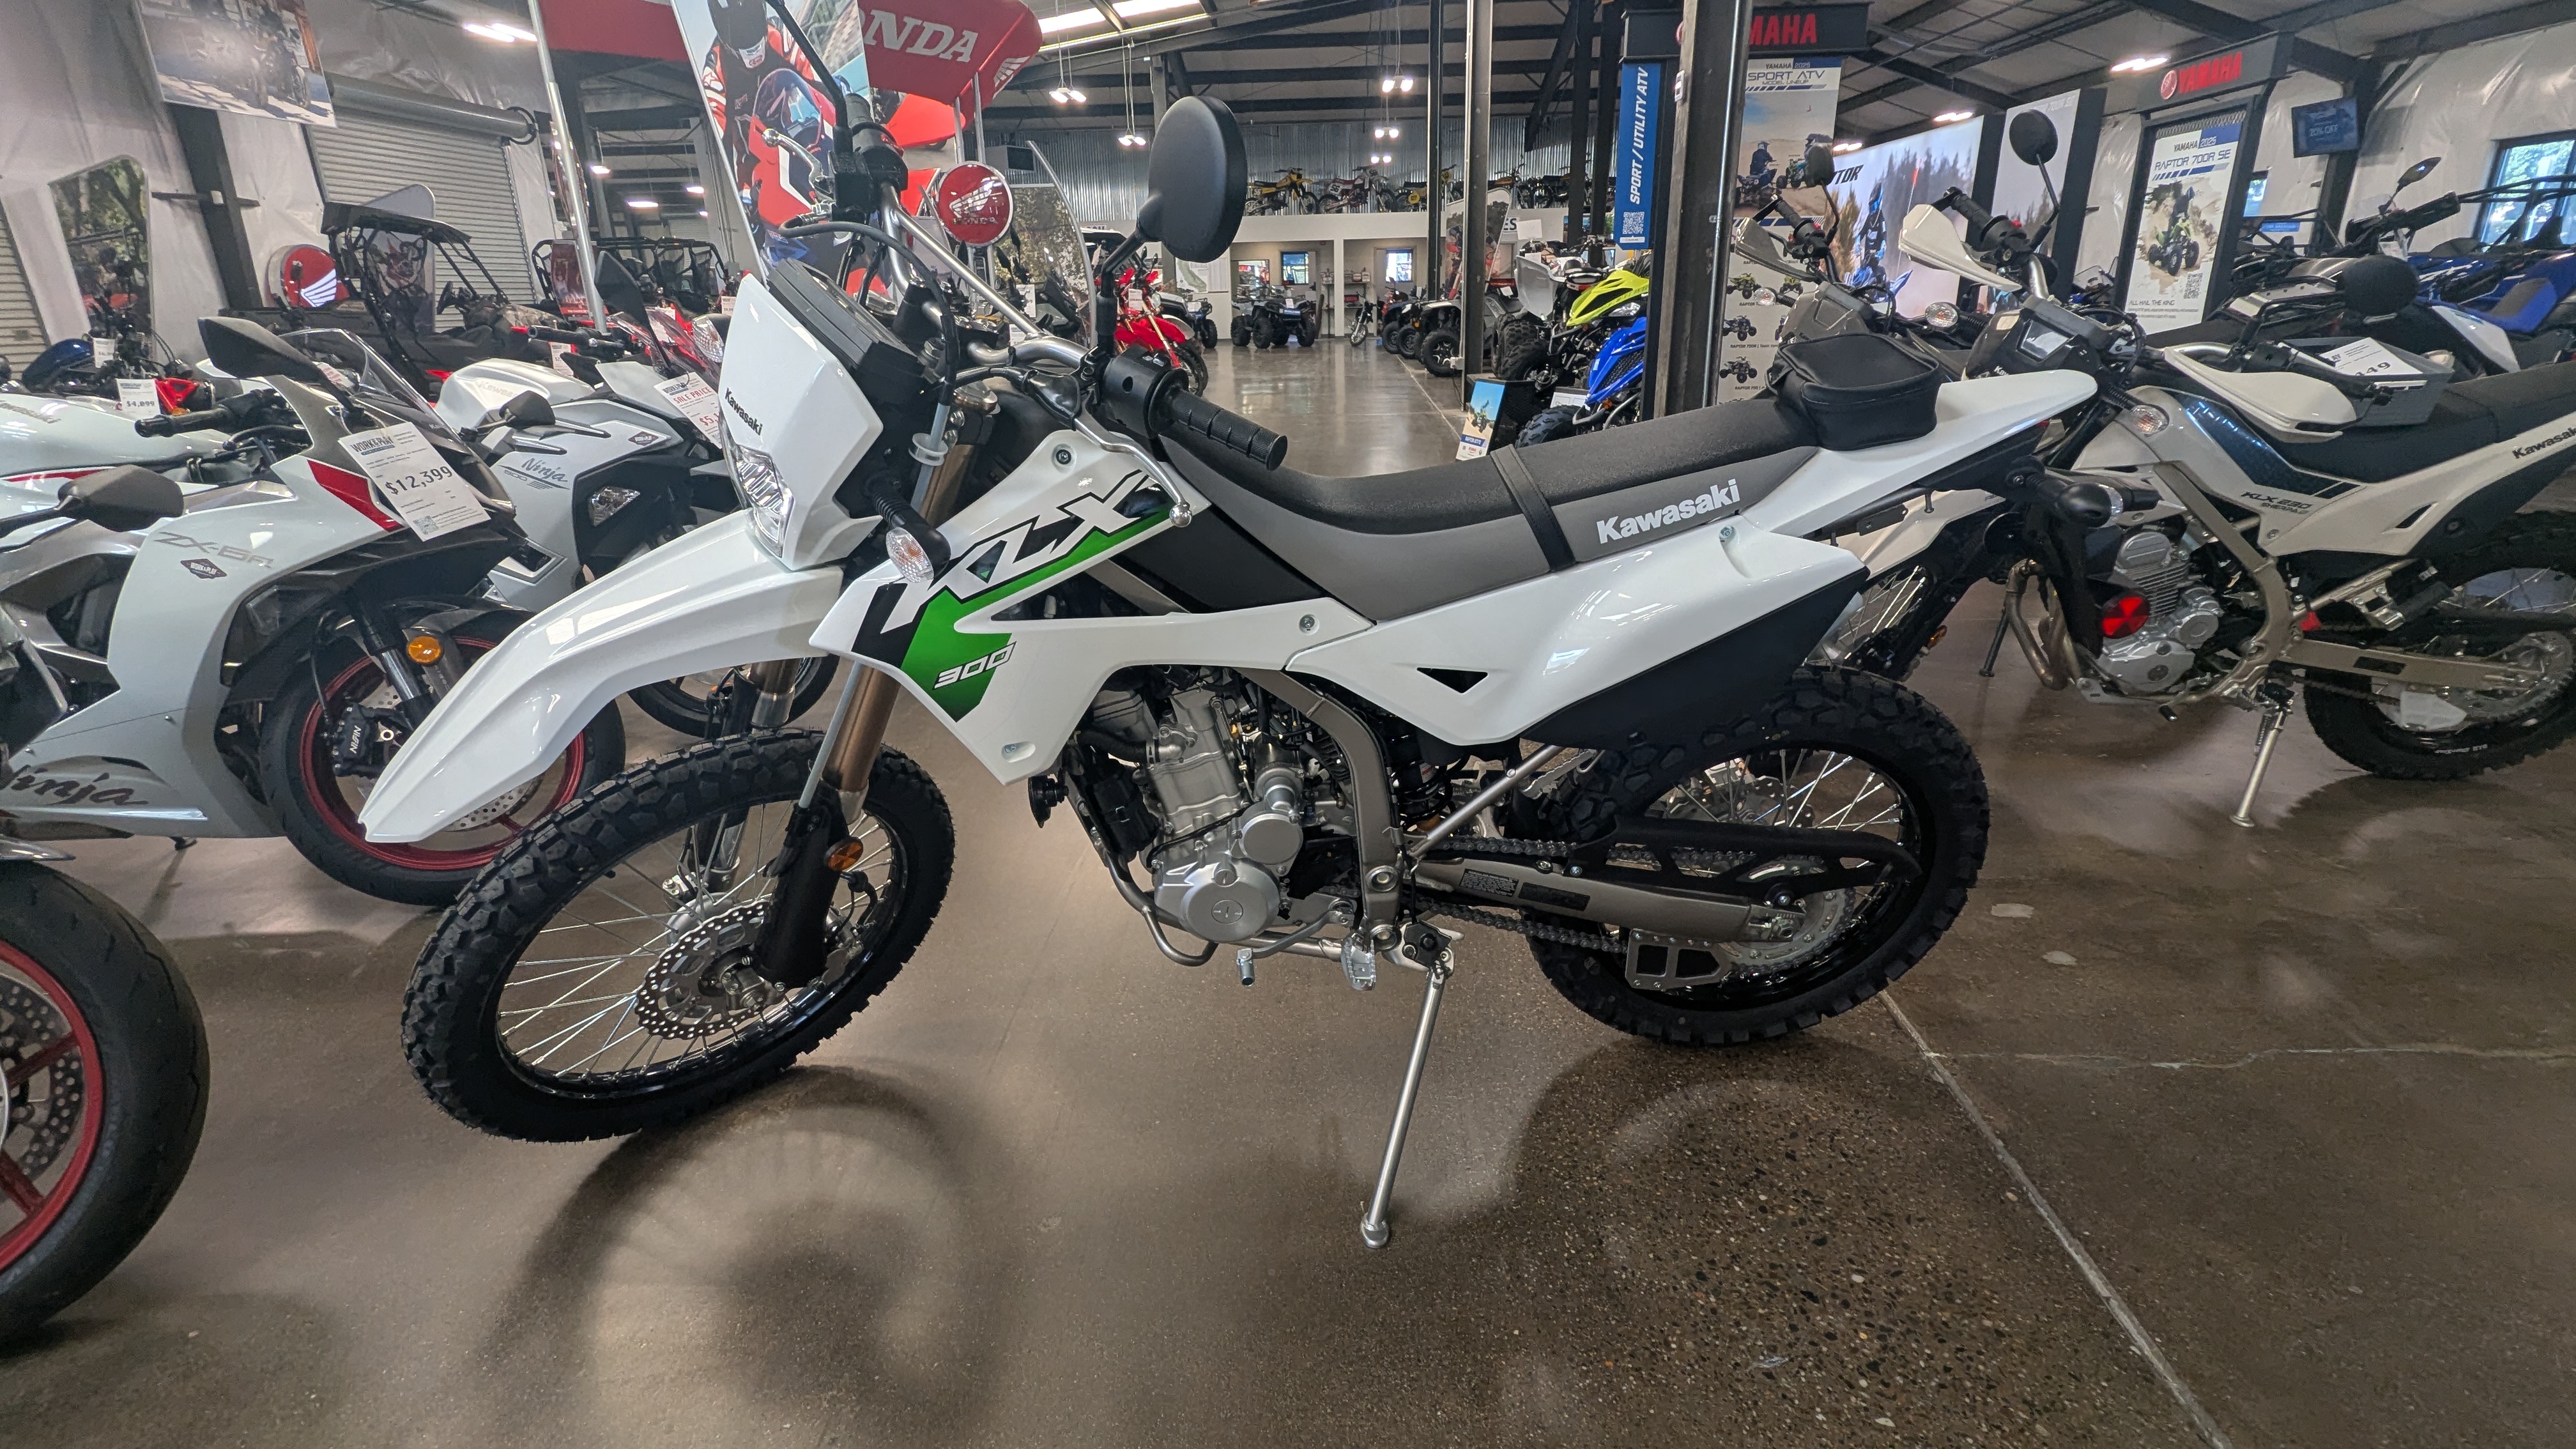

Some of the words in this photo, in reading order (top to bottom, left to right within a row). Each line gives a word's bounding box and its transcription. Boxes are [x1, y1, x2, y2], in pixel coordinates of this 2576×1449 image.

[859, 8, 978, 63] NDA
[1749, 13, 1817, 45] MAHA
[1637, 66, 1649, 96] ATV
[1748, 71, 1793, 81] SPORT
[1797, 70, 1825, 80] ATV
[2178, 52, 2242, 94] YAMAHA
[1634, 95, 1647, 149] UTILITY
[2155, 156, 2189, 171] RAPTOR
[2192, 152, 2216, 165] 700R
[2218, 149, 2231, 160] SE
[2174, 141, 2198, 152] YAMAHA
[2200, 136, 2217, 148] 2025
[1630, 160, 1643, 205] SPORT
[1834, 164, 1864, 185] TOR
[673, 394, 692, 404] SALE
[690, 387, 712, 398] PRICE
[724, 387, 763, 436] Kawasaki
[2511, 427, 2576, 459] Kawasak
[385, 466, 453, 495] $12,399
[521, 457, 568, 482] Ninja
[1597, 479, 1740, 544] Kawasaki
[2241, 491, 2278, 503] KLX
[2277, 499, 2312, 509] 230
[154, 532, 274, 568] ZX-6R
[933, 642, 1016, 689] 300
